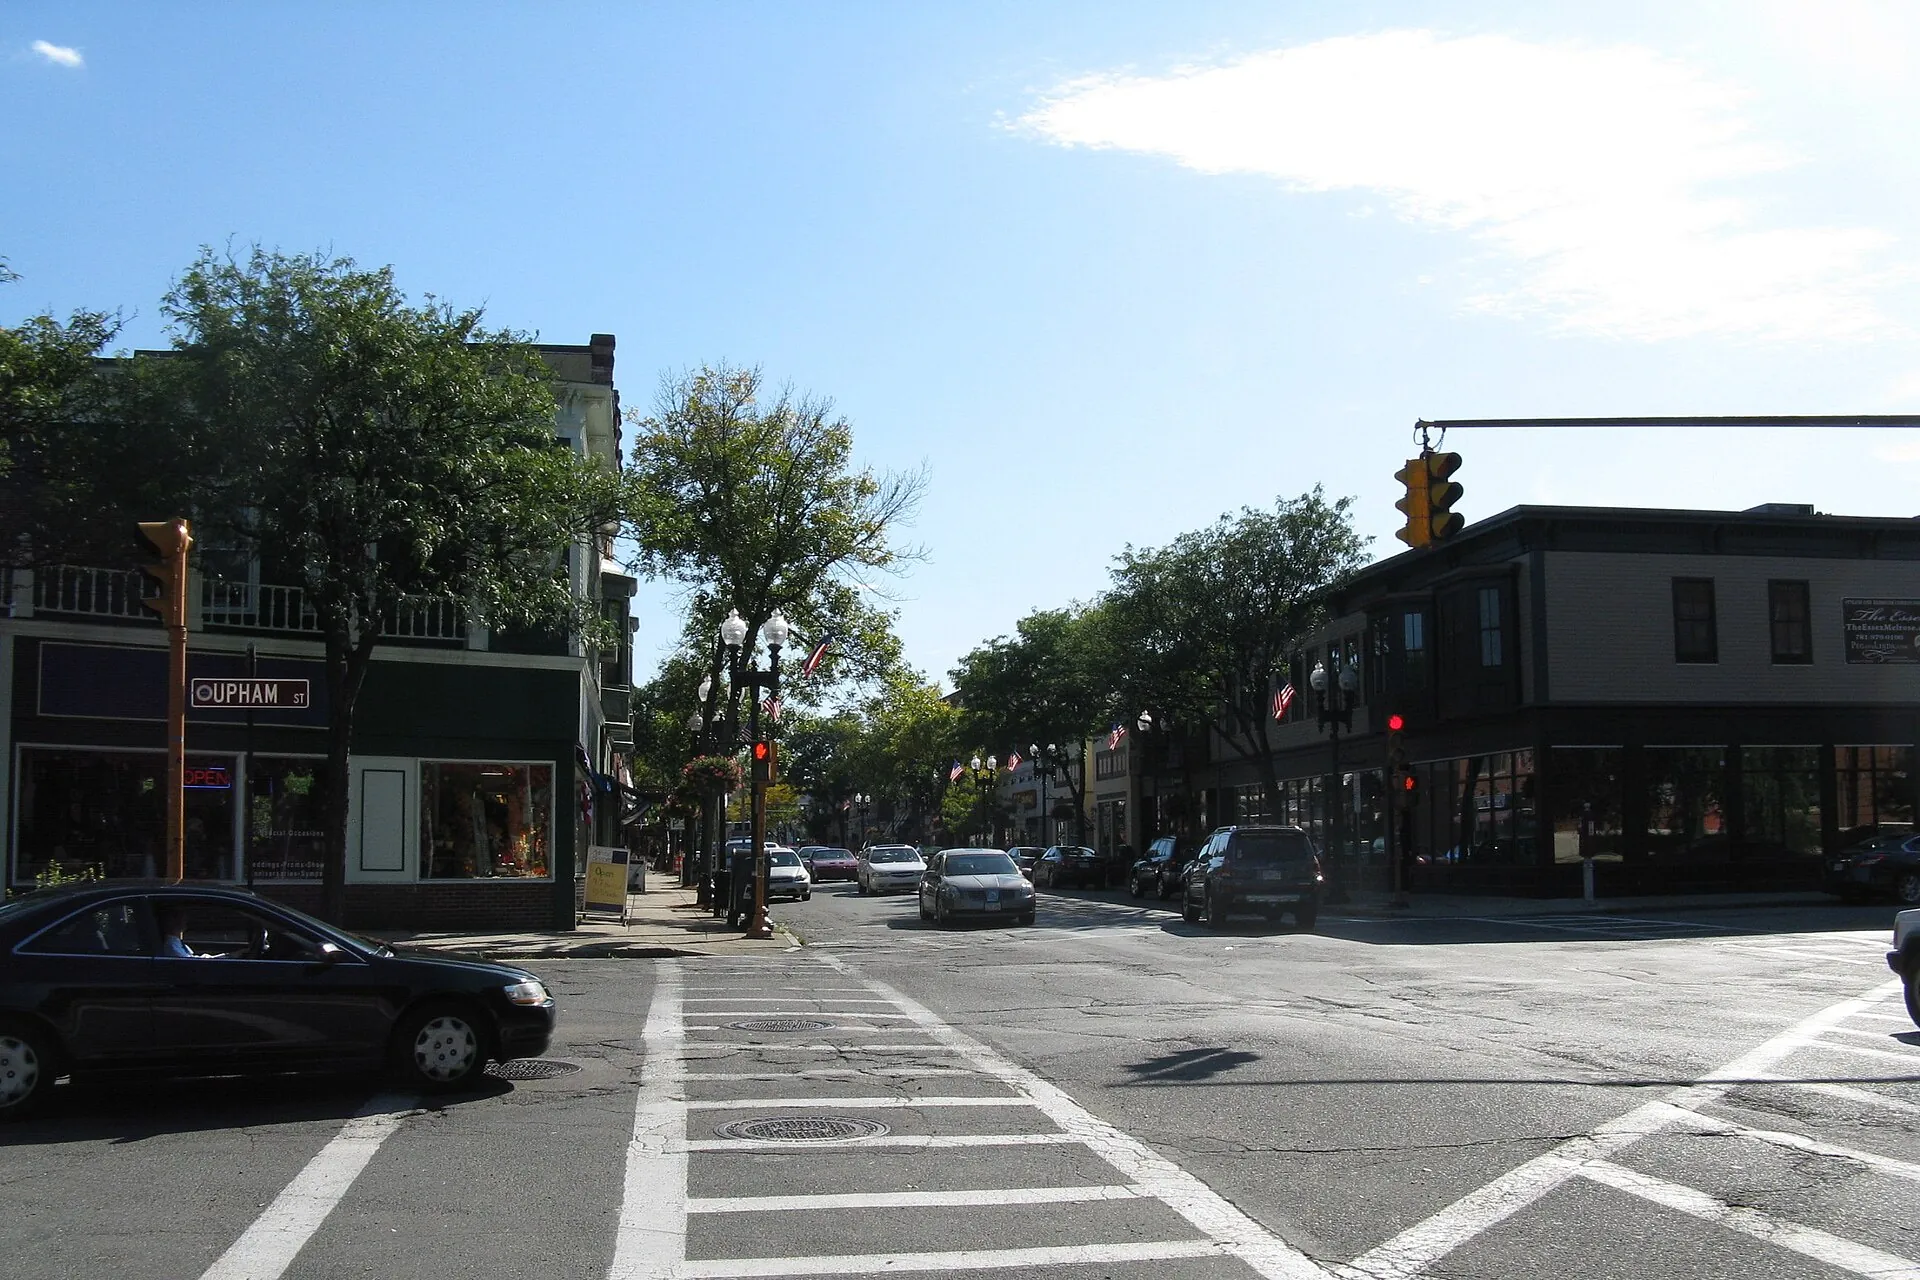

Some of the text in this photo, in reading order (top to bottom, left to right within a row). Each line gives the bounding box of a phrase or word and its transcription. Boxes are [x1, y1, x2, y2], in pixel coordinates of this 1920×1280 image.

[1850, 608, 1920, 621] The Esse
[213, 683, 304, 704] UPHAM ST
[185, 770, 230, 786] OPEN
